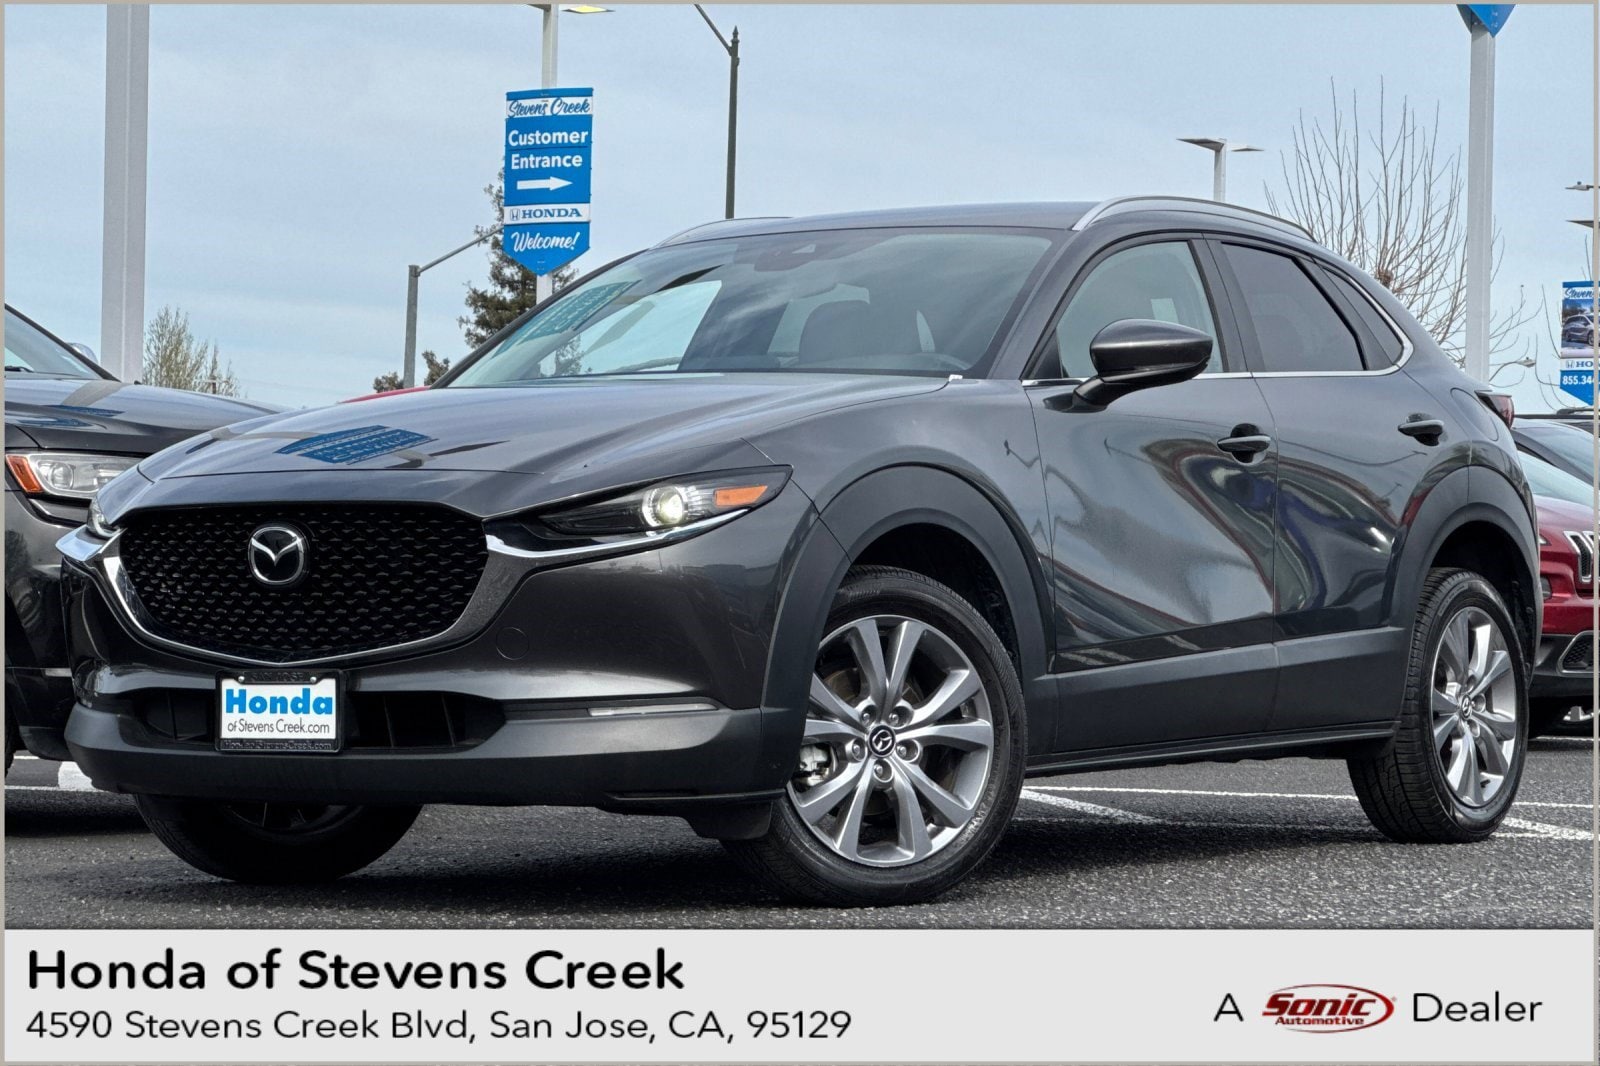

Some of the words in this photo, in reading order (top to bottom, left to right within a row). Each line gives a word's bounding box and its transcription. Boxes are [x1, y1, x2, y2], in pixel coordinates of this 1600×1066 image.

[508, 100, 548, 118] Stevens
[550, 97, 590, 116] Creek
[508, 129, 588, 146] Customer
[511, 153, 583, 170] Entrance
[521, 208, 582, 219] HONDA
[510, 231, 580, 252] Welcome!
[1564, 287, 1594, 298] Steven
[226, 688, 333, 715] Honda
[227, 720, 238, 732] of
[239, 718, 274, 733] Stevens
[276, 717, 330, 734] Creek.com
